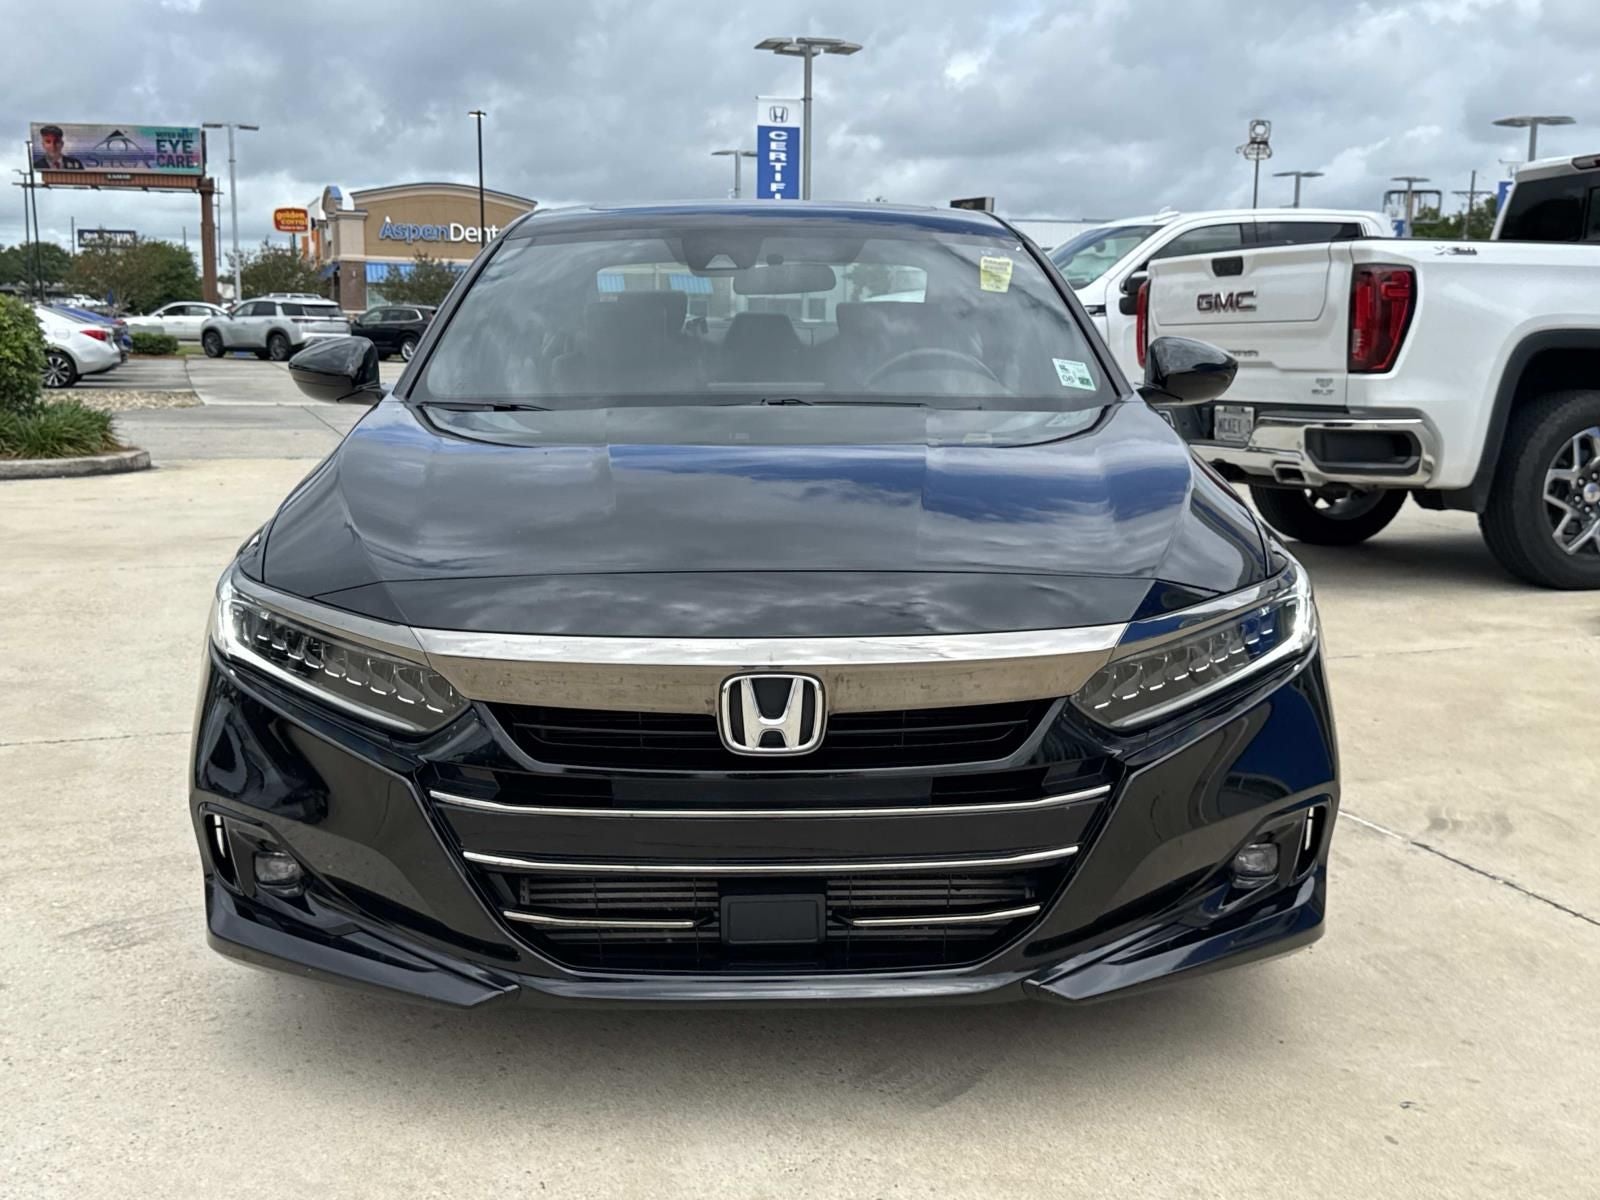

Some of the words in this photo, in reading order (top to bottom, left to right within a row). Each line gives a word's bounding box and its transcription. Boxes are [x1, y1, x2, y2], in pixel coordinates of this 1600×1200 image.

[156, 139, 193, 154] EYE
[156, 154, 194, 169] CARE
[380, 216, 503, 244] AspenDent
[1197, 291, 1257, 312] GMC
